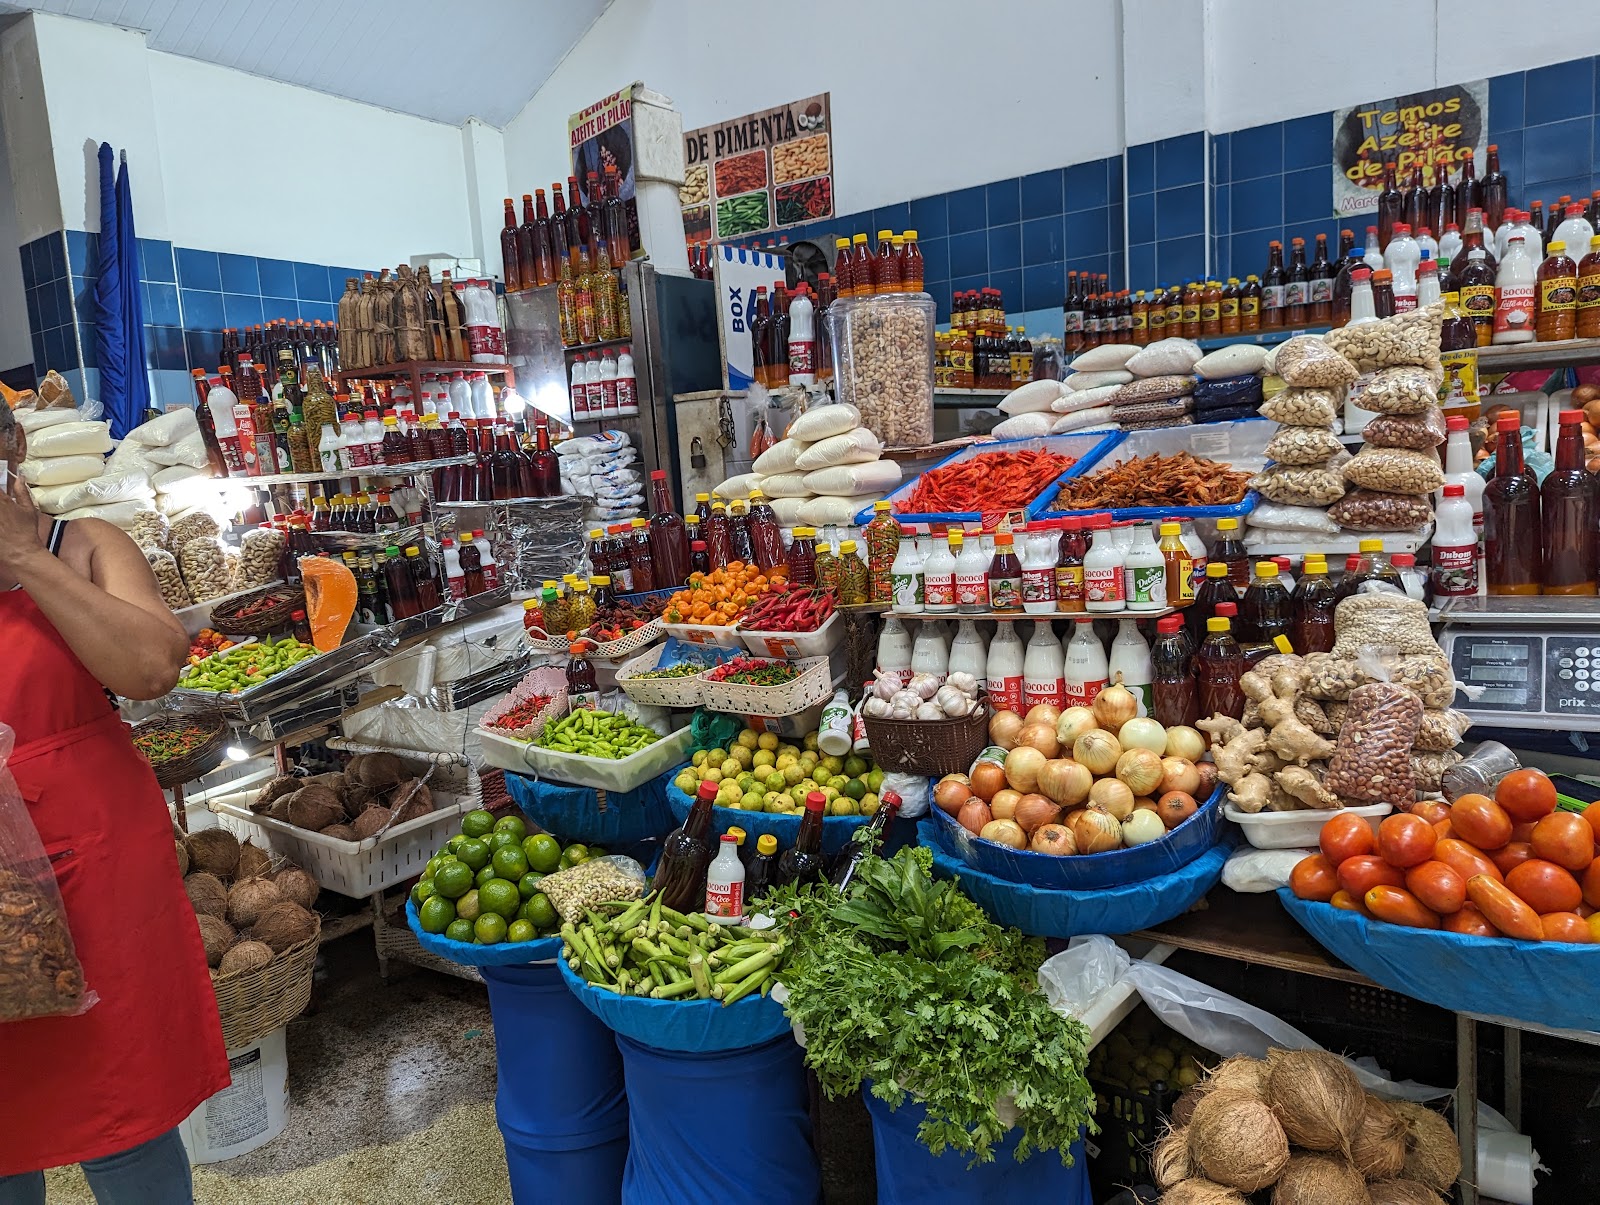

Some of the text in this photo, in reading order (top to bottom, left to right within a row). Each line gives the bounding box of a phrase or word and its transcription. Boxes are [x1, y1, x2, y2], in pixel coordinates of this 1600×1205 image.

[1357, 98, 1460, 128] Temos
[571, 99, 630, 146] AZEITE DE PILÃO
[686, 109, 797, 164] DE PIMENTA
[1356, 124, 1462, 155] Azeite
[1346, 144, 1473, 179] de Pilão
[1503, 288, 1534, 297] SOCOCO
[729, 286, 744, 333] BOX
[1440, 551, 1472, 560] Dubom
[1136, 570, 1162, 589] Ducoco
[992, 694, 1007, 703] Coco
[1041, 697, 1059, 706] Coco
[1071, 699, 1088, 707] Coco
[1560, 697, 1586, 708] prix
[716, 895, 731, 903] Coco
